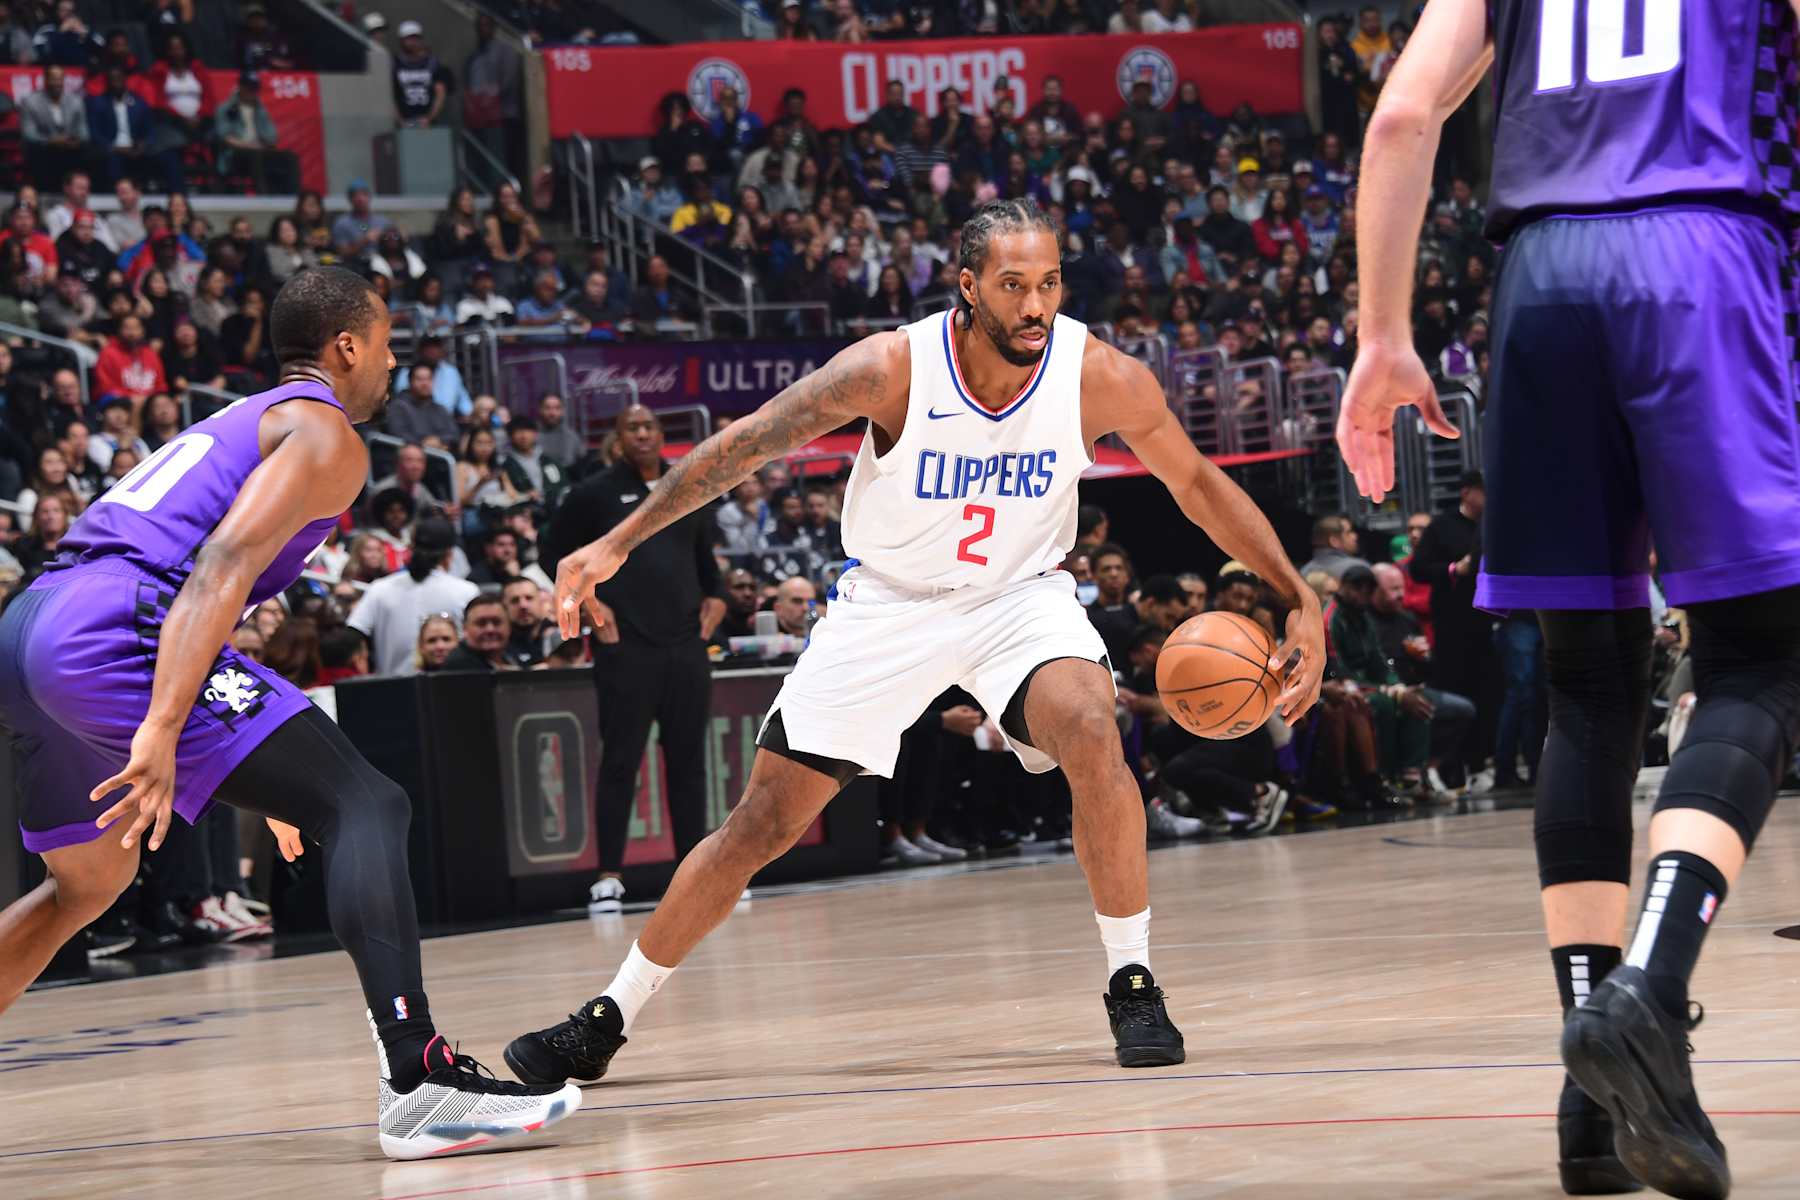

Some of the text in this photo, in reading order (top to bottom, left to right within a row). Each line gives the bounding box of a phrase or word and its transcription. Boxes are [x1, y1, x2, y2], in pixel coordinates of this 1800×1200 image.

[553, 49, 591, 72] 105
[1263, 29, 1297, 49] 105
[1537, 0, 1682, 91] 10
[271, 75, 310, 99] 104
[100, 432, 215, 512] 0
[915, 448, 1057, 500] CLIPPERS
[957, 503, 996, 566] 2
